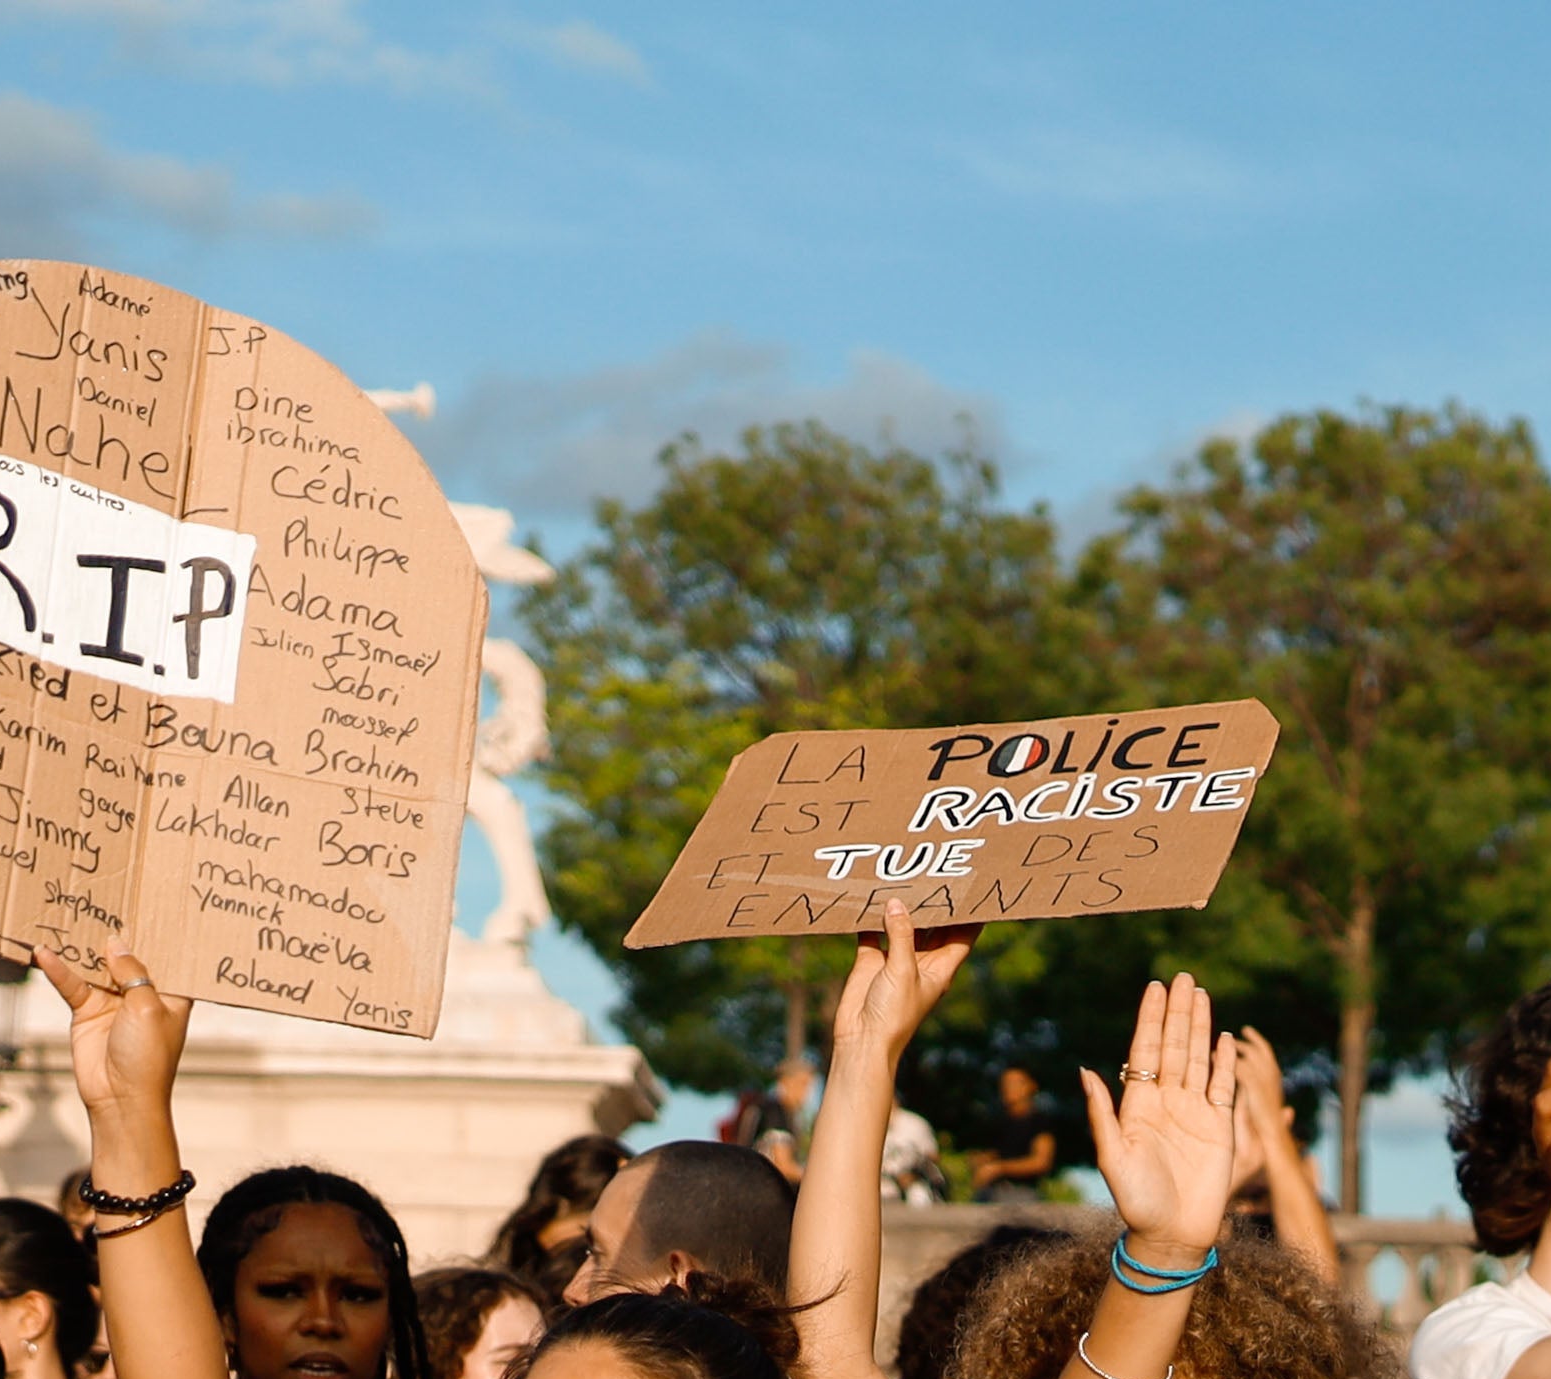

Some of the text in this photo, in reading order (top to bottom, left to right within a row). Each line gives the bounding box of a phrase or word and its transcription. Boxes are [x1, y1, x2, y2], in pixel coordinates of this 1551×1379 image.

[15, 287, 168, 382] Yanis
[78, 376, 157, 427] Daniel
[235, 386, 313, 423] Dine
[271, 464, 402, 520] Cédric
[284, 515, 410, 578] Philippe
[247, 563, 404, 638] Adama
[90, 684, 128, 724] et
[141, 701, 278, 766] Bouna
[776, 718, 1221, 786] LA POLICE
[223, 775, 290, 818] Allan
[749, 767, 1255, 834] EST RACISTE
[318, 821, 417, 878] Boris
[706, 825, 1160, 890] ET TUE DES
[725, 867, 1124, 929] ENFANTS
[216, 956, 314, 1005] Roland
[336, 985, 414, 1030] Yanis
